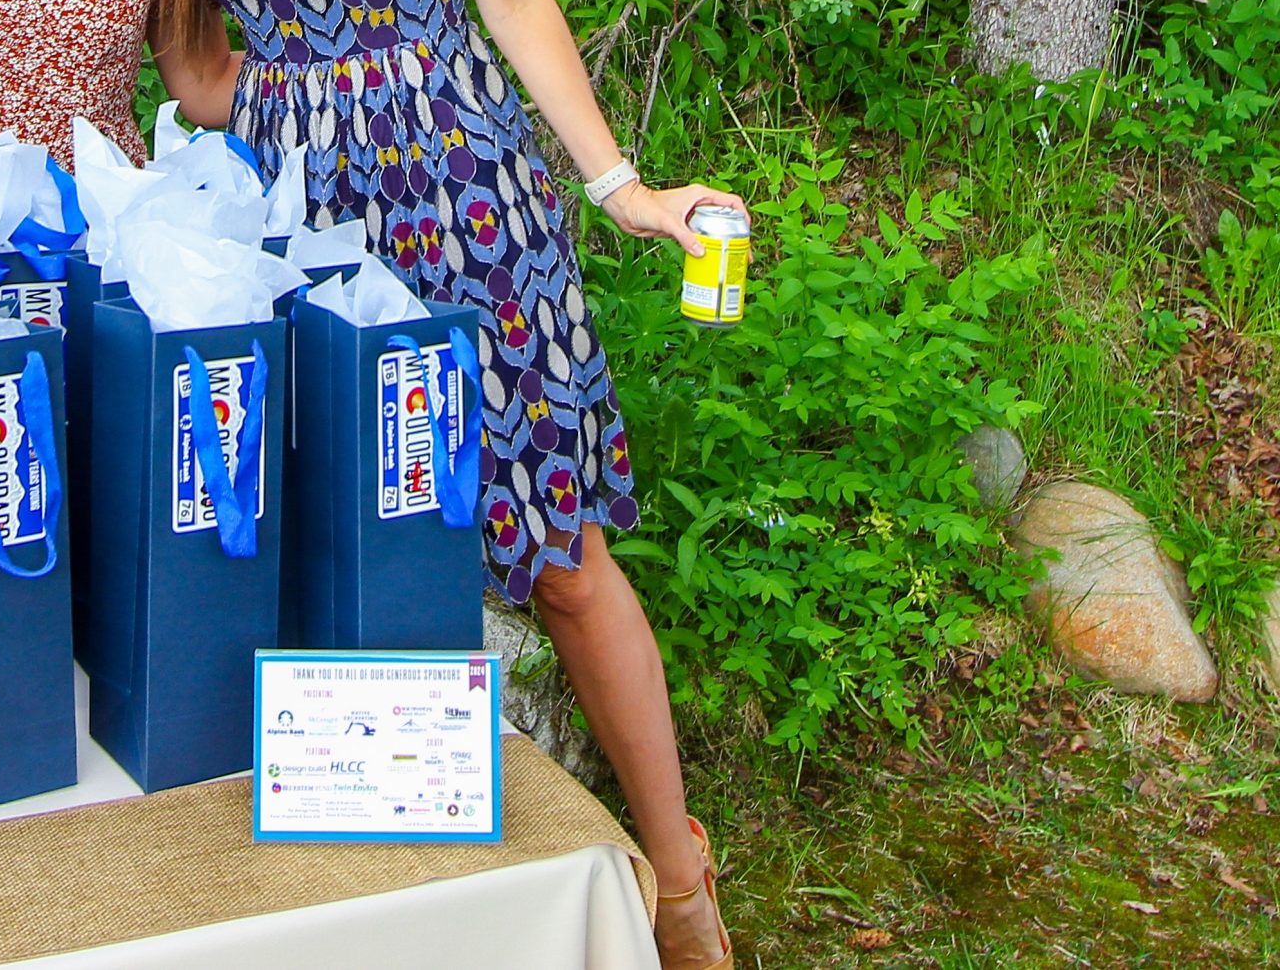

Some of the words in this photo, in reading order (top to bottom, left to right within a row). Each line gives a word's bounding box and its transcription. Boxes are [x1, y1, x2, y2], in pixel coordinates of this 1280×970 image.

[25, 288, 51, 316] MY
[385, 365, 396, 379] 18
[180, 377, 192, 392] 18
[207, 368, 231, 396] MY
[385, 420, 395, 447] Alpine
[181, 433, 192, 458] Alpine
[404, 387, 432, 507] COLORADO
[385, 449, 395, 470] Bank
[181, 460, 192, 483] Bank
[385, 489, 396, 504] 76
[180, 502, 192, 518] 76
[293, 668, 315, 680] THANK
[318, 669, 332, 680] YOU
[334, 669, 343, 680] TO
[345, 669, 357, 680] ALL
[359, 669, 368, 680] OF
[370, 669, 385, 681] OUR
[386, 669, 421, 681] GENEROUS
[424, 669, 461, 681] SPONSORS
[470, 666, 485, 676] 2024
[267, 728, 288, 736] Alpine
[282, 765, 307, 774] design
[329, 761, 366, 773] HLCC
